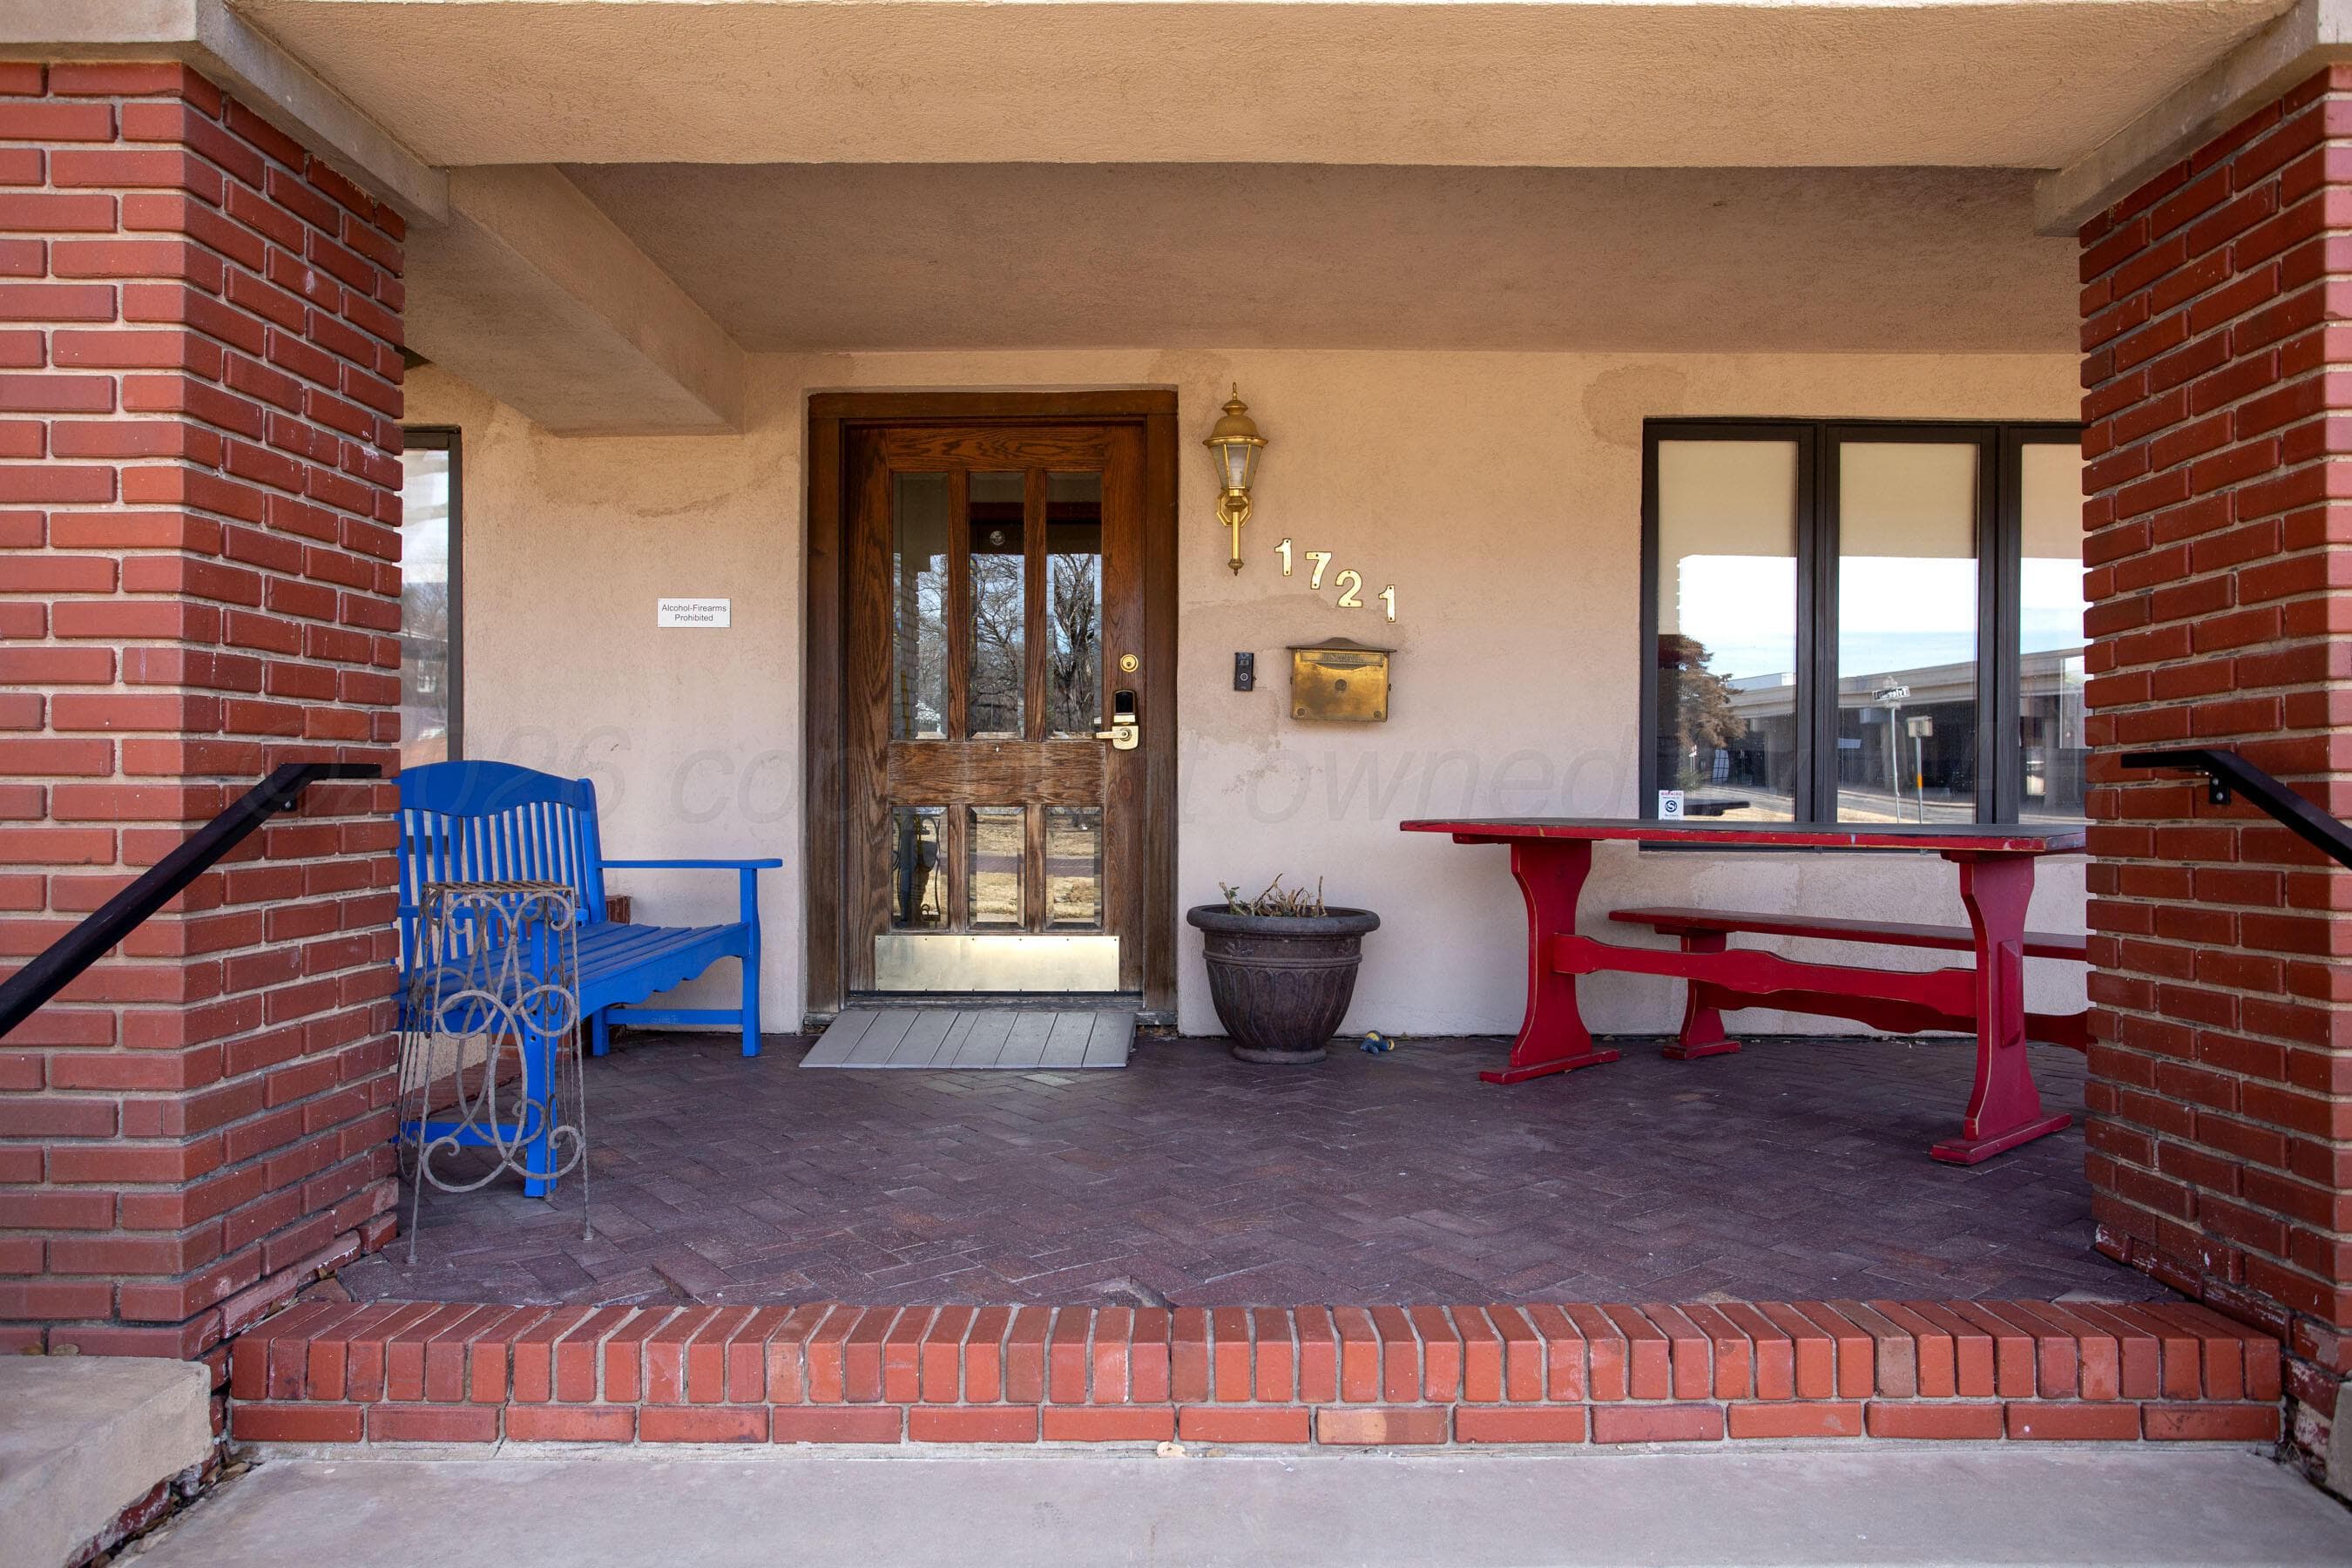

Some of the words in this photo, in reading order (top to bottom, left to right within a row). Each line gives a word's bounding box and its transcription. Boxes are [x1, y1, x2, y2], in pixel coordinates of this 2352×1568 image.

[1274, 537, 1396, 623] 1721
[661, 604, 727, 612] Alcohol-Firearms
[674, 613, 713, 622] Prohibited
